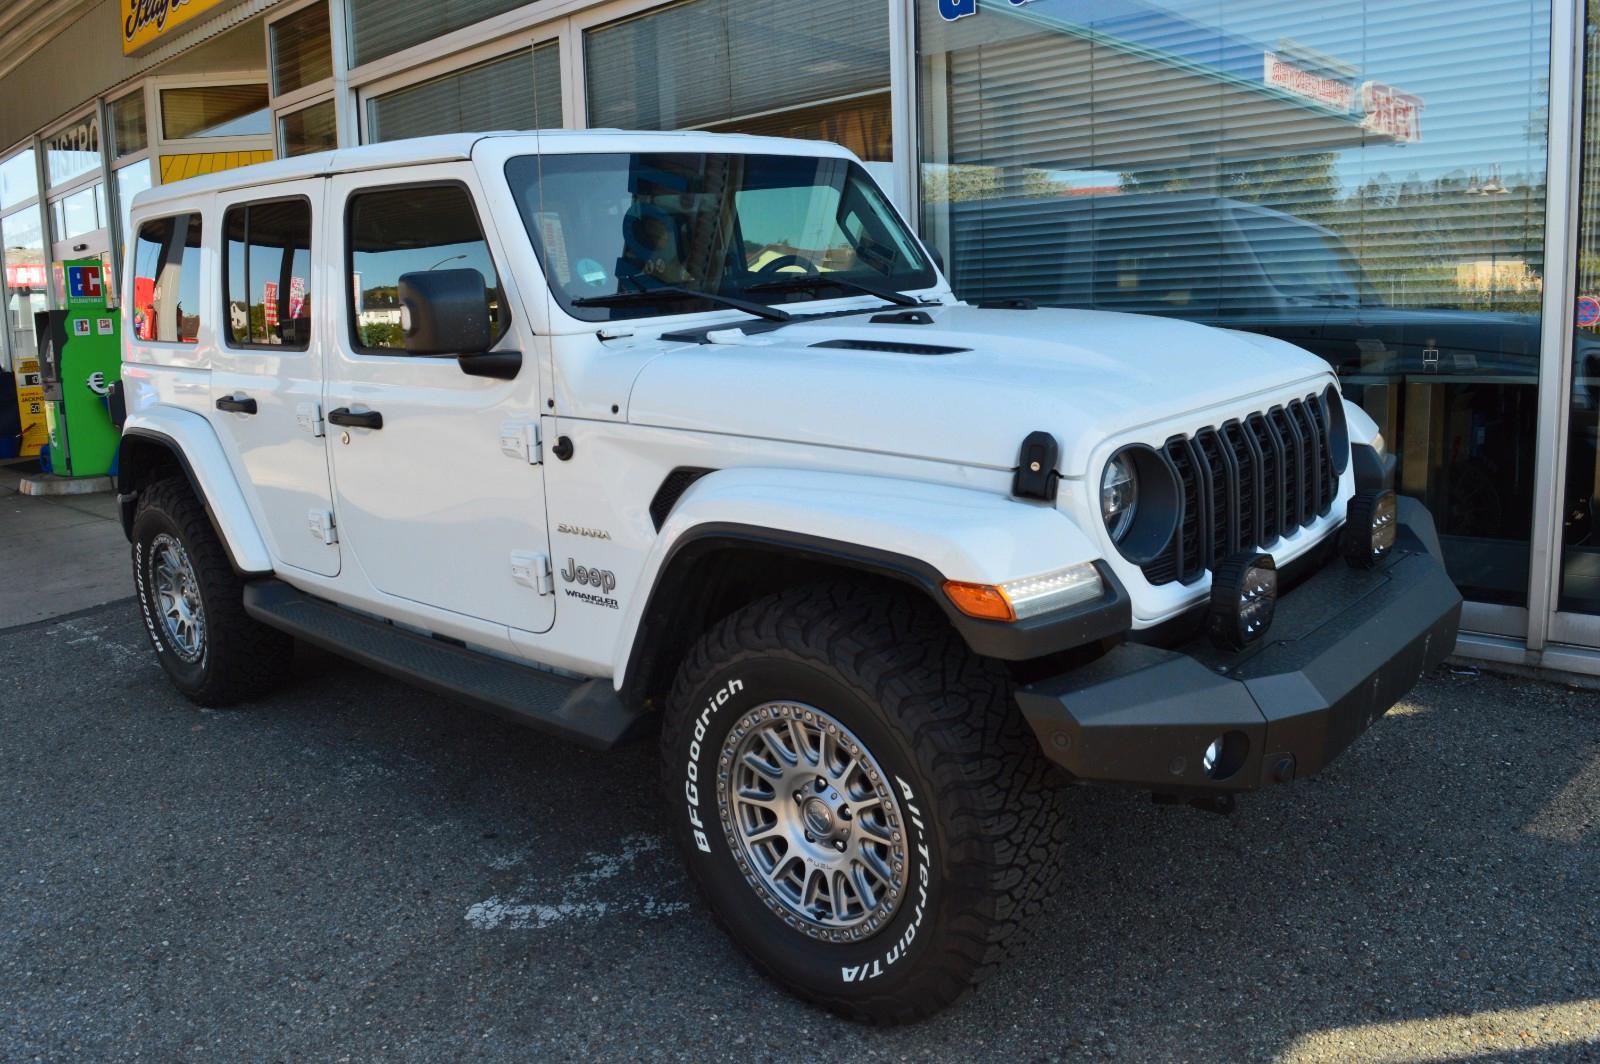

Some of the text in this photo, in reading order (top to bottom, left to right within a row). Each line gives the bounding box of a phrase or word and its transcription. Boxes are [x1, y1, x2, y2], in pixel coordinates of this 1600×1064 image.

[558, 524, 611, 540] SAHARA
[135, 542, 164, 652] BFGoodrich
[561, 558, 616, 594] Jeep
[565, 589, 618, 606] WRANGLER
[685, 679, 744, 853] BFGoodrich
[841, 775, 930, 983] All-Terrain T/A
